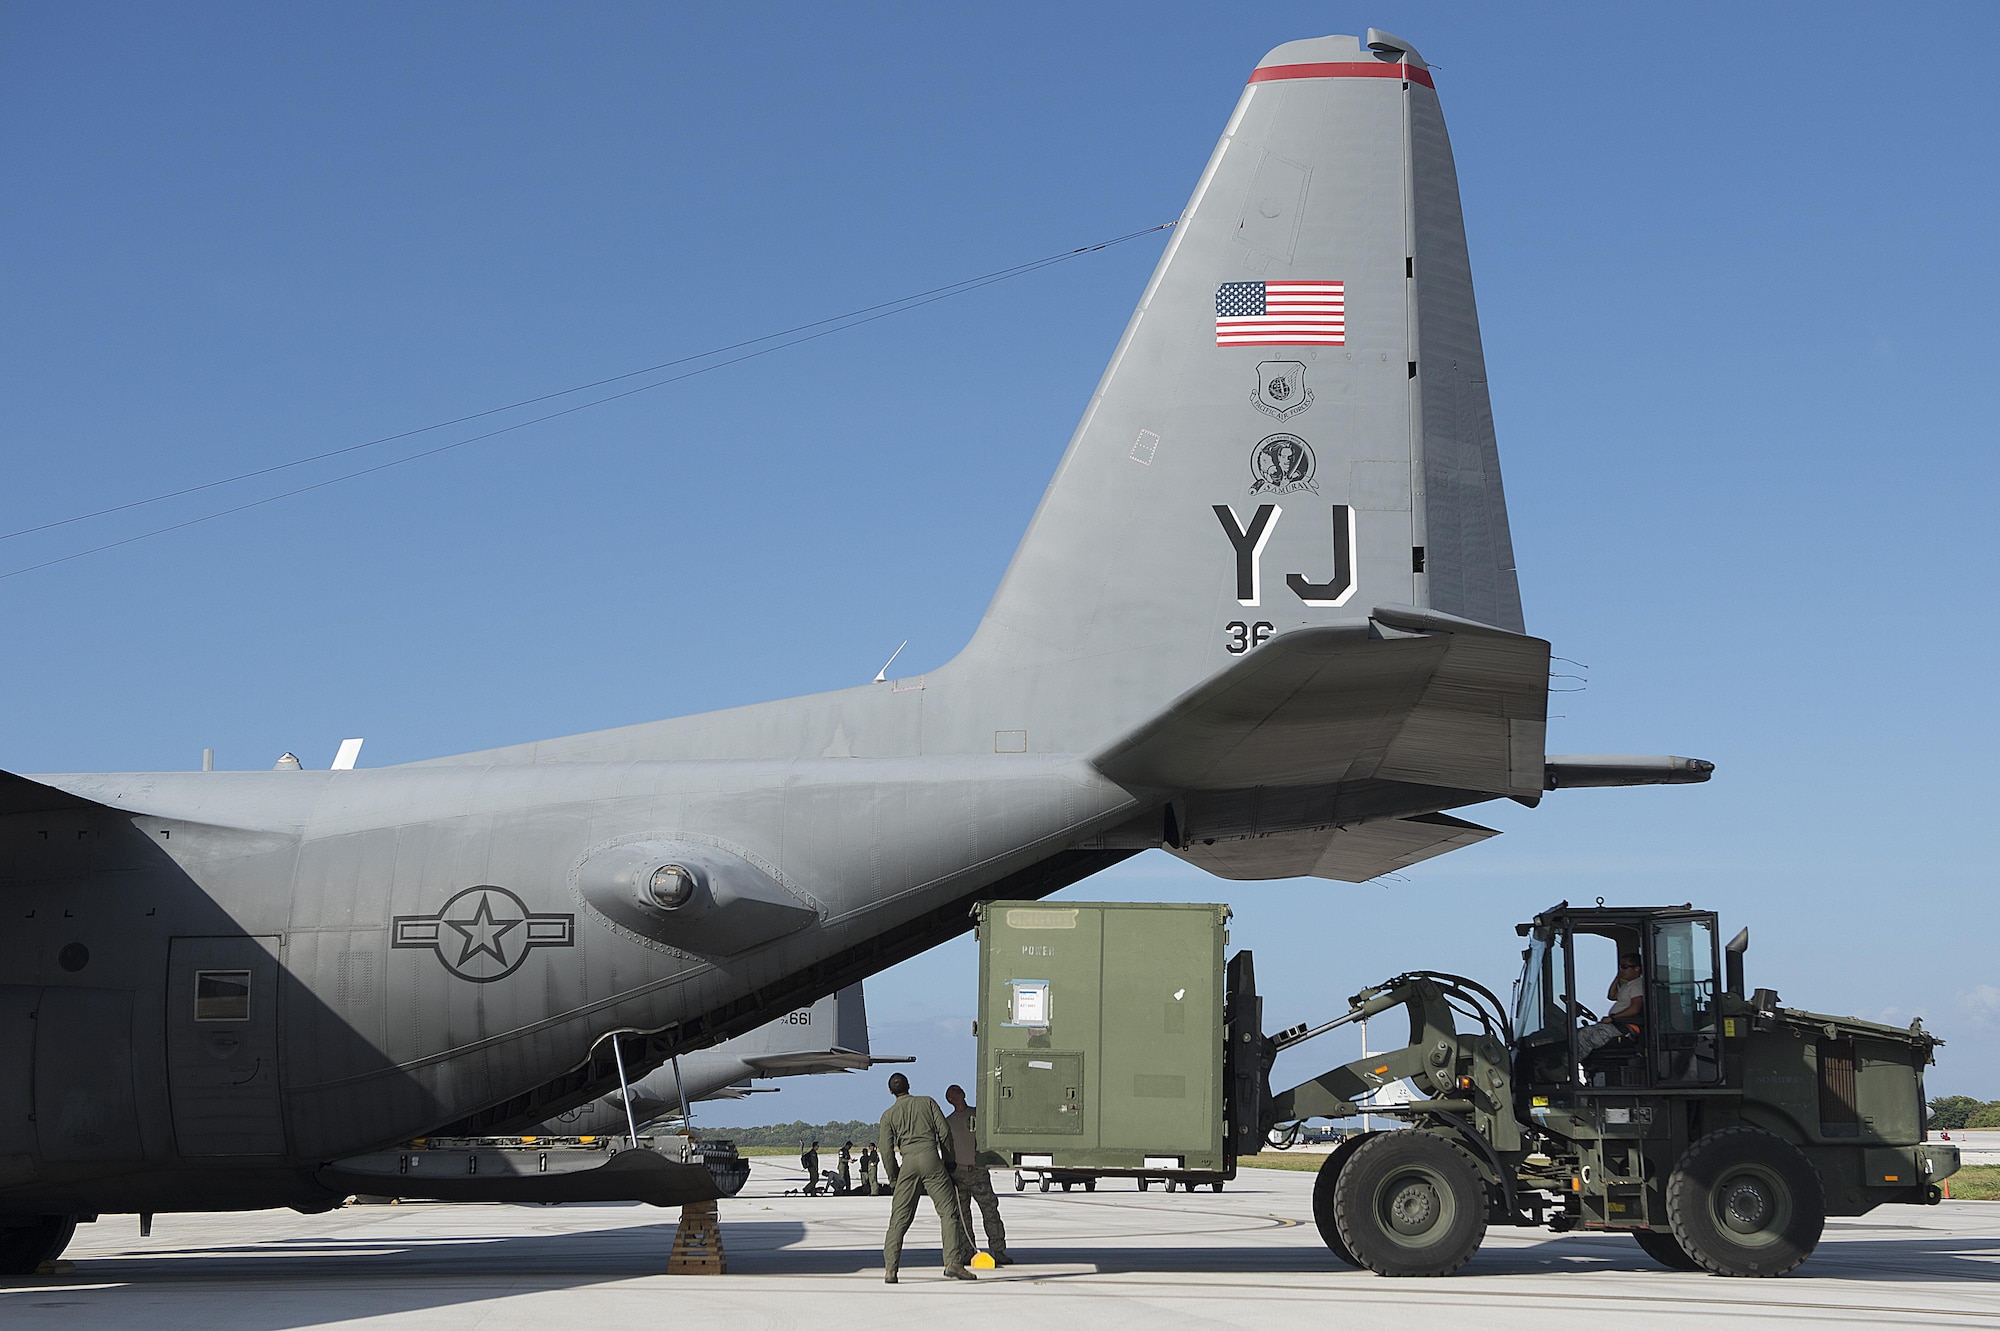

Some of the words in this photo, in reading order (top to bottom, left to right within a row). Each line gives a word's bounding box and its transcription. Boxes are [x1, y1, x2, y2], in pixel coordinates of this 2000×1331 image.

[1254, 400, 1277, 416] PACIFIC
[1276, 412, 1289, 420] AIR
[1290, 399, 1311, 415] FORCES
[1263, 482, 1309, 494] SAMURAI
[1022, 945, 1055, 956] POWER
[789, 1012, 811, 1026] 661
